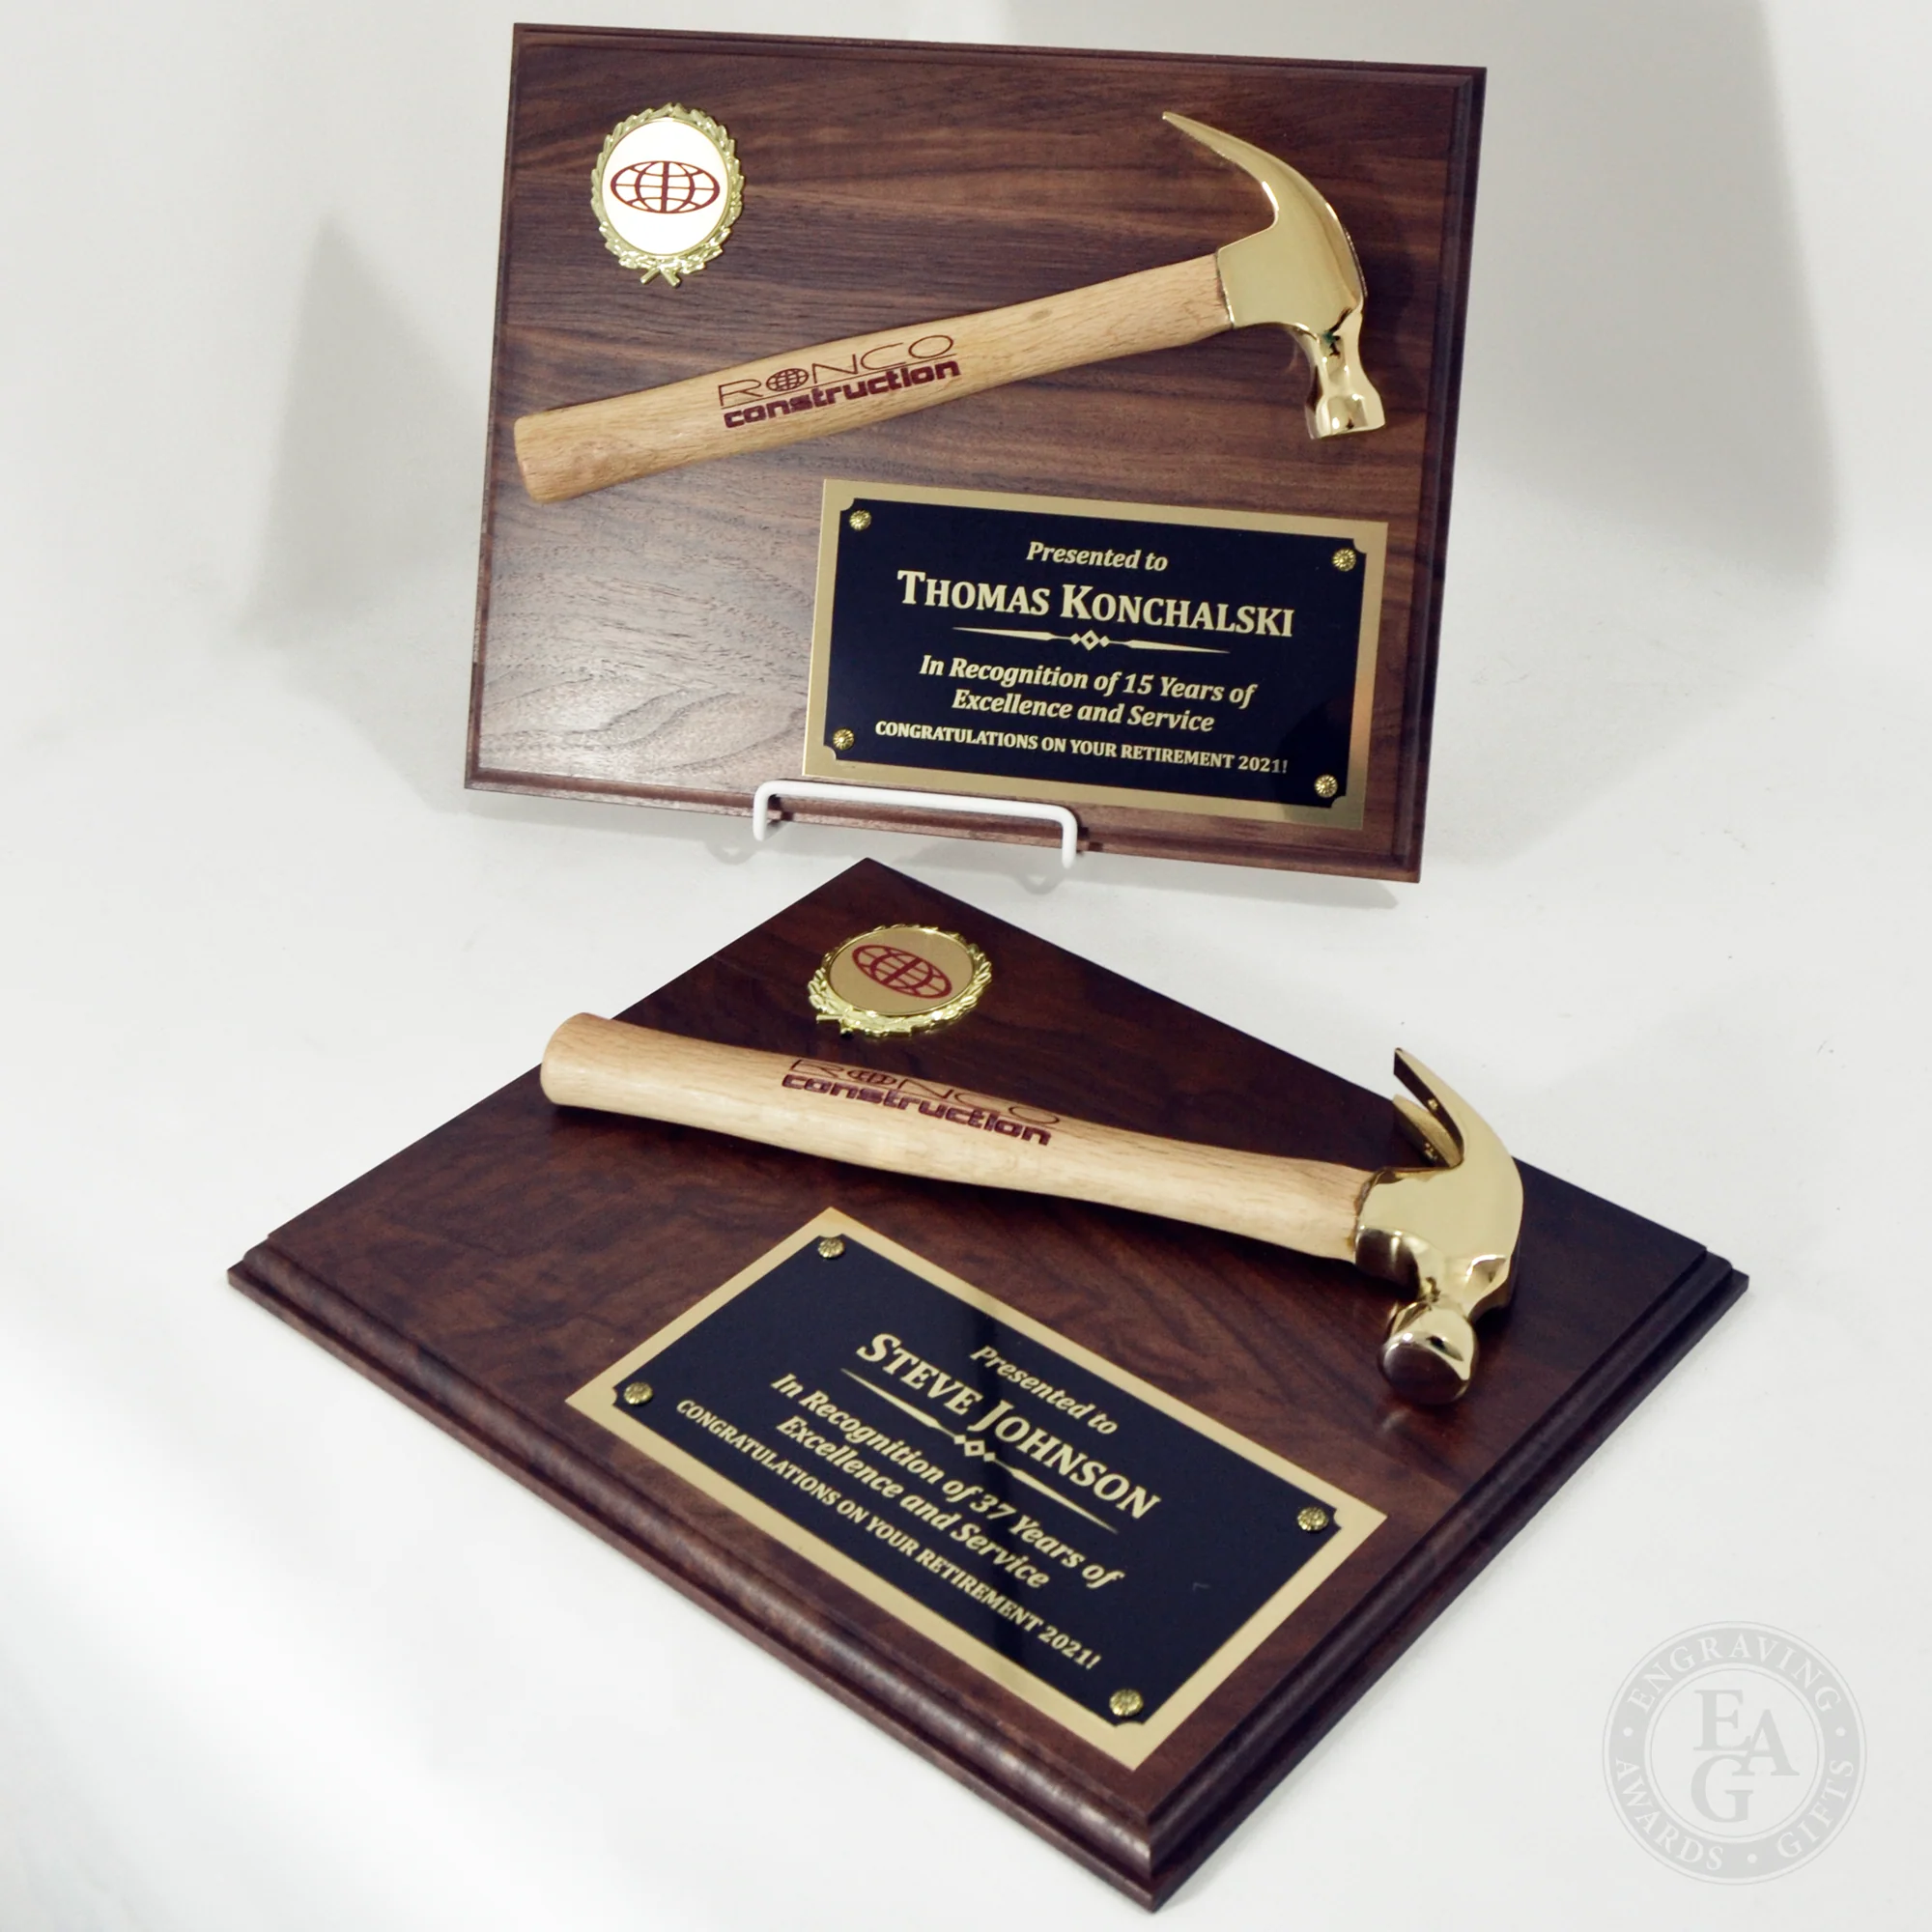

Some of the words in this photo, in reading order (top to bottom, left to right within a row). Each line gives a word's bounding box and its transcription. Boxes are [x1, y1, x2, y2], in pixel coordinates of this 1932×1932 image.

[718, 334, 953, 407] RONCO
[724, 360, 961, 428] construction
[1026, 541, 1140, 570] Presented
[1145, 552, 1168, 572] to
[896, 570, 1050, 616] THOMAS
[1060, 583, 1294, 638] KONCHALSKI
[919, 655, 944, 676] In
[949, 658, 1089, 691] Recognition
[1094, 670, 1123, 696] of
[1124, 673, 1154, 695] 15
[1159, 677, 1224, 702] Years
[1229, 684, 1258, 709] of
[952, 689, 1072, 719] Excellence
[1077, 698, 1122, 724] and
[1127, 706, 1215, 731] Service
[875, 721, 1038, 751] CONGRATULATIONS
[1040, 737, 1065, 753] ON
[1069, 739, 1118, 757] YOUR
[1121, 744, 1235, 770] RETIREMENT
[1237, 754, 1288, 773] 2021!
[781, 1073, 1052, 1146] construction
[856, 1332, 983, 1417] STEVE
[968, 1400, 1161, 1520] JOHNSON
[970, 1345, 1094, 1422] Presented
[1089, 1409, 1119, 1435] to
[771, 1374, 803, 1400] In
[798, 1383, 951, 1486] Recognition
[943, 1473, 979, 1504] of
[970, 1487, 1016, 1520] 37
[1009, 1514, 1087, 1570] Years
[1082, 1559, 1124, 1588] of
[777, 1415, 904, 1499] Excellence
[900, 1491, 959, 1533] and
[951, 1519, 1050, 1588] Service
[677, 1399, 838, 1506] CONGRATULATIONS
[837, 1496, 869, 1524] ON
[866, 1514, 920, 1558] YOUR
[914, 1548, 1045, 1633] RETIREMENT
[1038, 1621, 1101, 1672] 2021!
